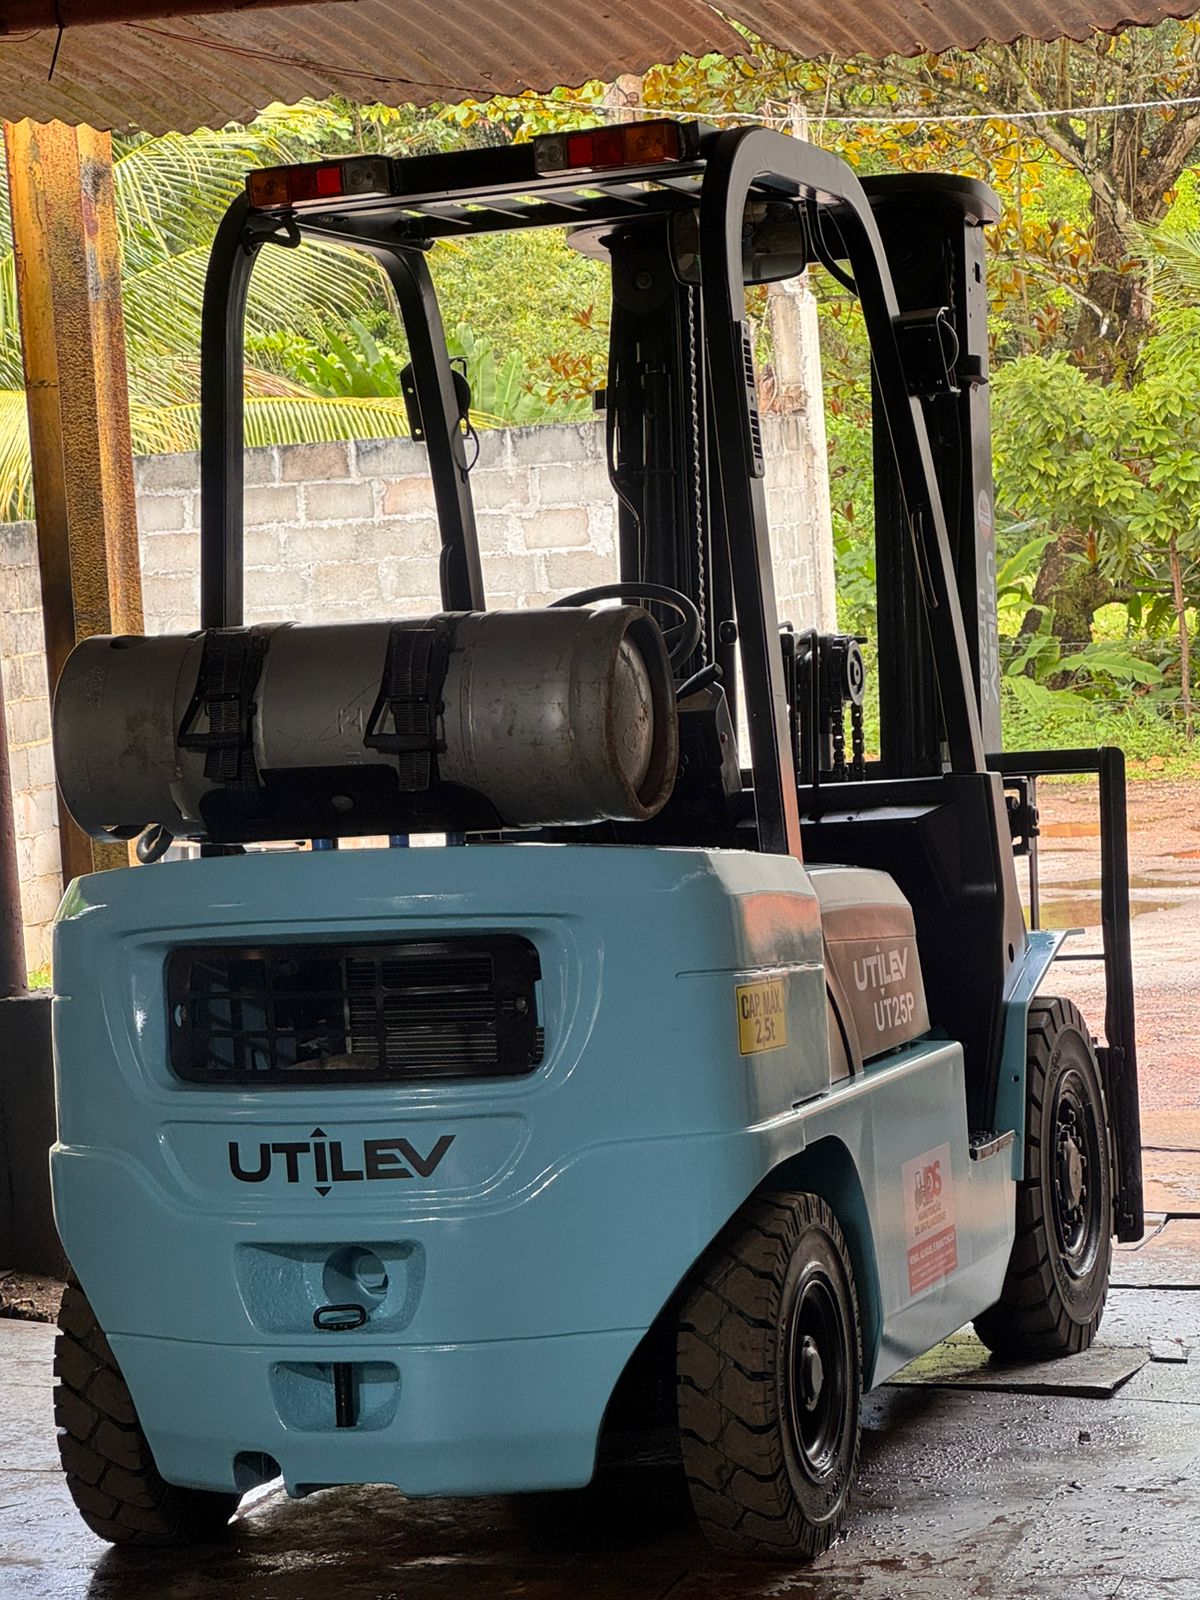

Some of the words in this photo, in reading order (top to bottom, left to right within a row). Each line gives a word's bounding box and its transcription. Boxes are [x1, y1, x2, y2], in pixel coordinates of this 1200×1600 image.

[986, 551, 999, 703] UTILEV
[853, 947, 908, 992] UTILEV
[873, 992, 915, 1032] UT25P
[228, 1132, 457, 1184] UTILEV
